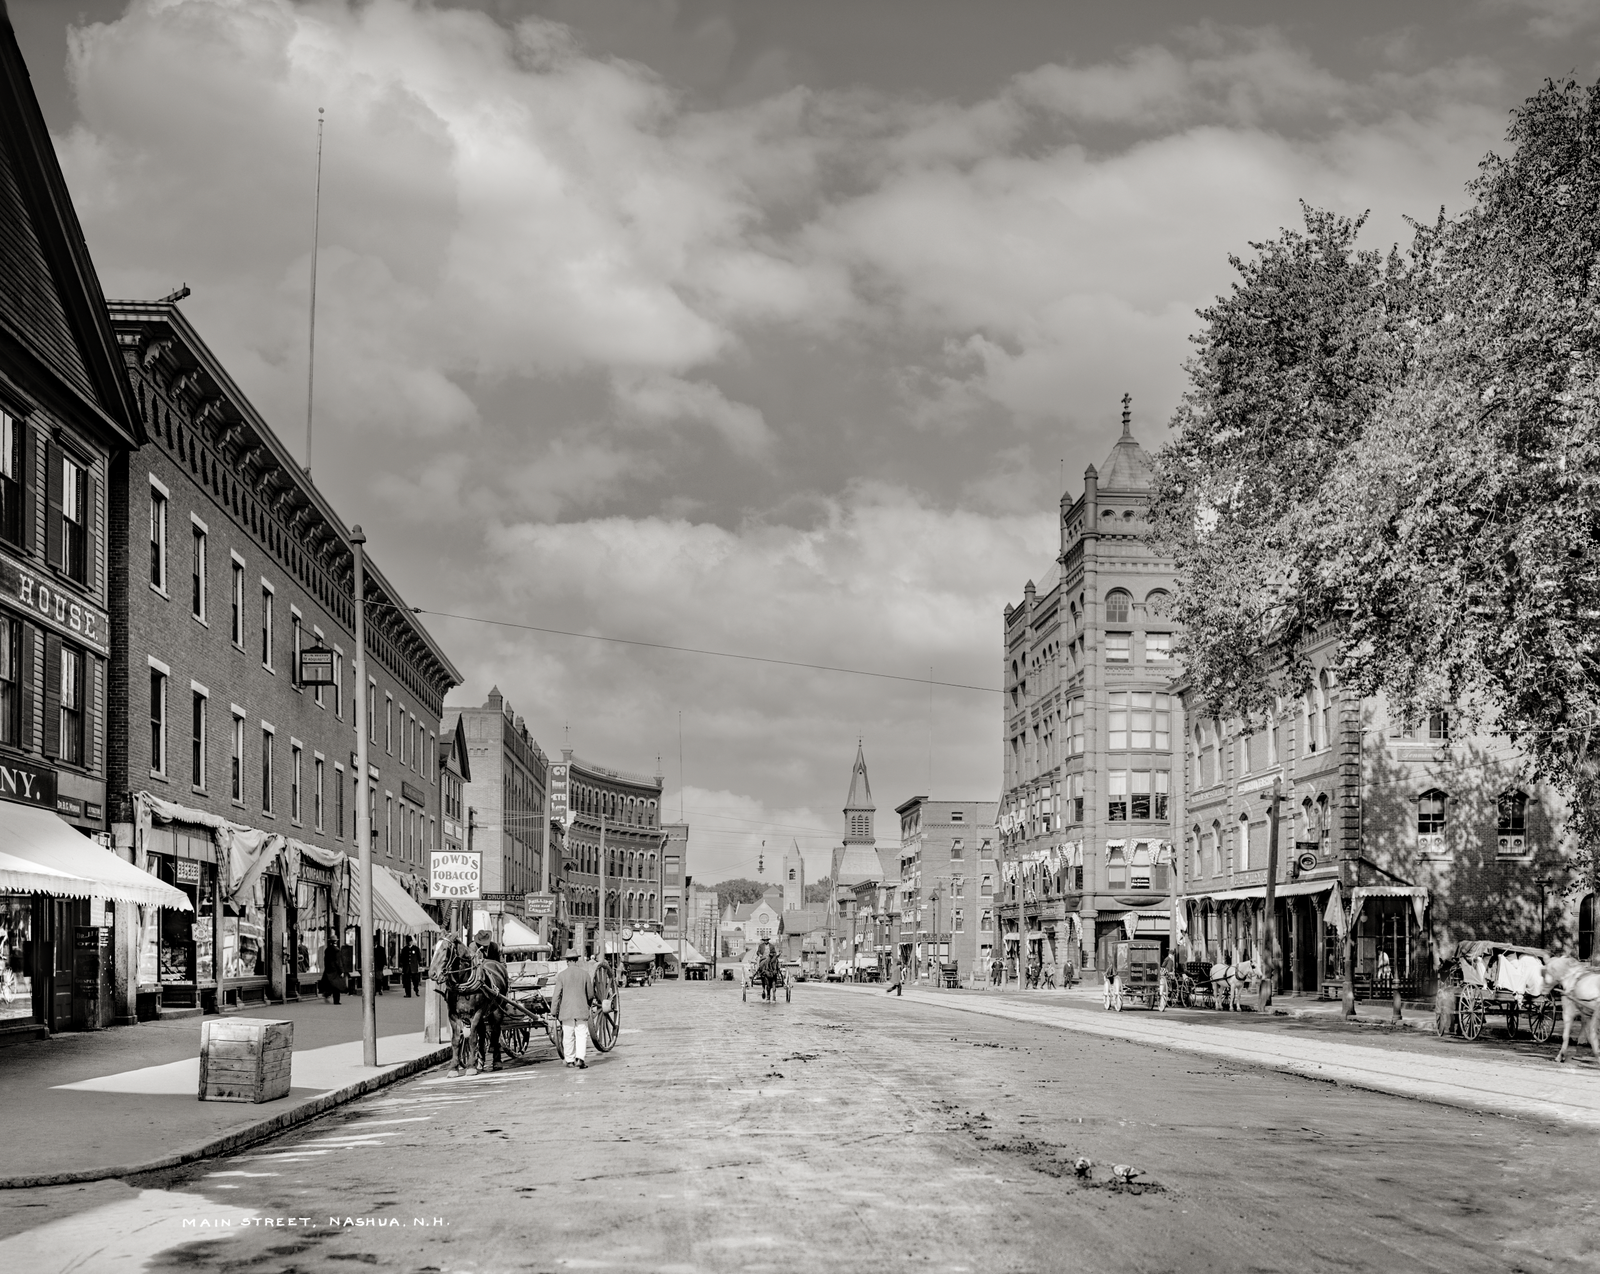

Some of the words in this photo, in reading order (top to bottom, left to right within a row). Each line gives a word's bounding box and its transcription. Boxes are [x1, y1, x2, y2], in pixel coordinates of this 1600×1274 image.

[20, 573, 98, 640] HOUSE.
[432, 854, 479, 870] DOWD'S
[432, 870, 479, 881] TOBACCO
[432, 882, 479, 896] STORE.
